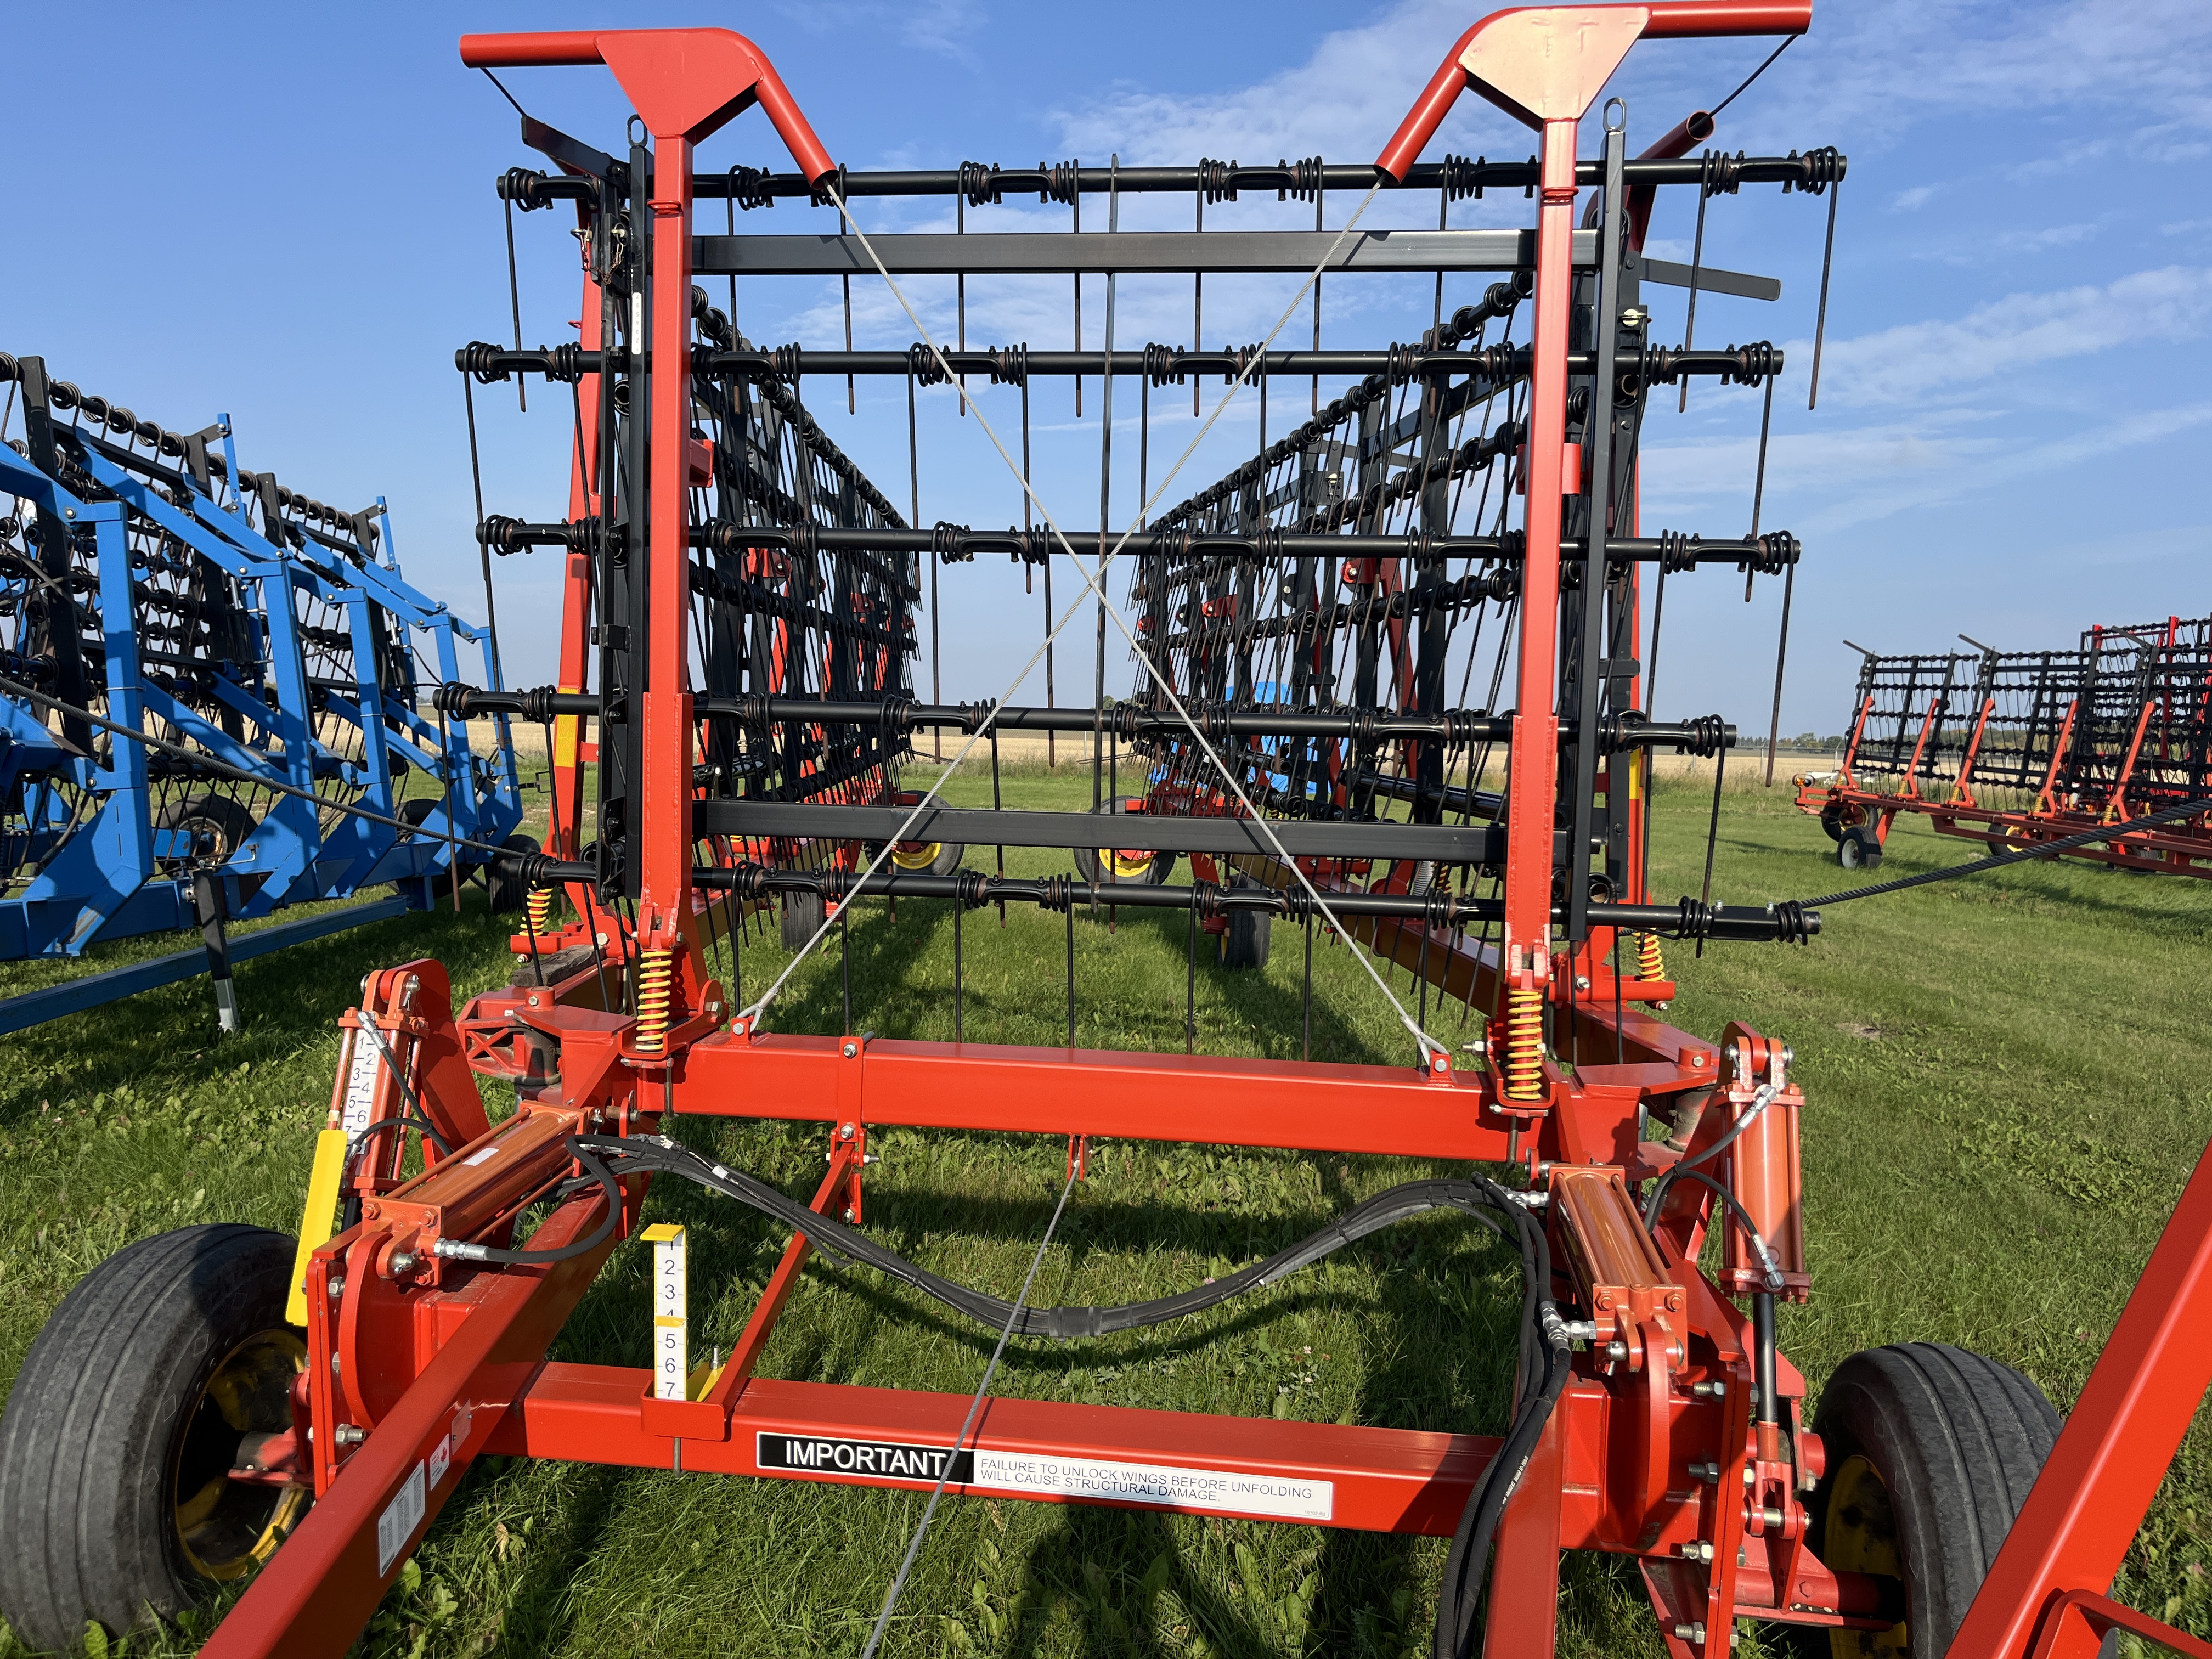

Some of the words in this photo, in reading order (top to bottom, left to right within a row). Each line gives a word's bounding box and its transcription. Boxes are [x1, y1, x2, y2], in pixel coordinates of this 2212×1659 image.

[359, 1037, 364, 1048] 1
[366, 1053, 376, 1065] 2
[353, 1068, 360, 1080] 3
[362, 1082, 370, 1093] 4
[349, 1096, 357, 1108] 5
[357, 1110, 366, 1122] 6
[664, 1260, 675, 1274] 2
[665, 1284, 675, 1299] 3
[665, 1334, 675, 1348] 5
[665, 1358, 675, 1373] 6
[665, 1382, 675, 1397] 7
[786, 1440, 947, 1476] IMPORTANT
[981, 1459, 1035, 1473] FAILURE
[1040, 1464, 1057, 1474] TO
[1063, 1466, 1117, 1480] UNLOCK
[1122, 1471, 1167, 1484] WINGS
[1172, 1476, 1227, 1491] BEFORE
[1232, 1482, 1312, 1498] UNFOLDING
[981, 1470, 1011, 1481] WILL
[1015, 1473, 1060, 1486] CAUSE
[1065, 1477, 1155, 1495] STRUCTURAL
[1159, 1486, 1221, 1502] DAMAGE.
